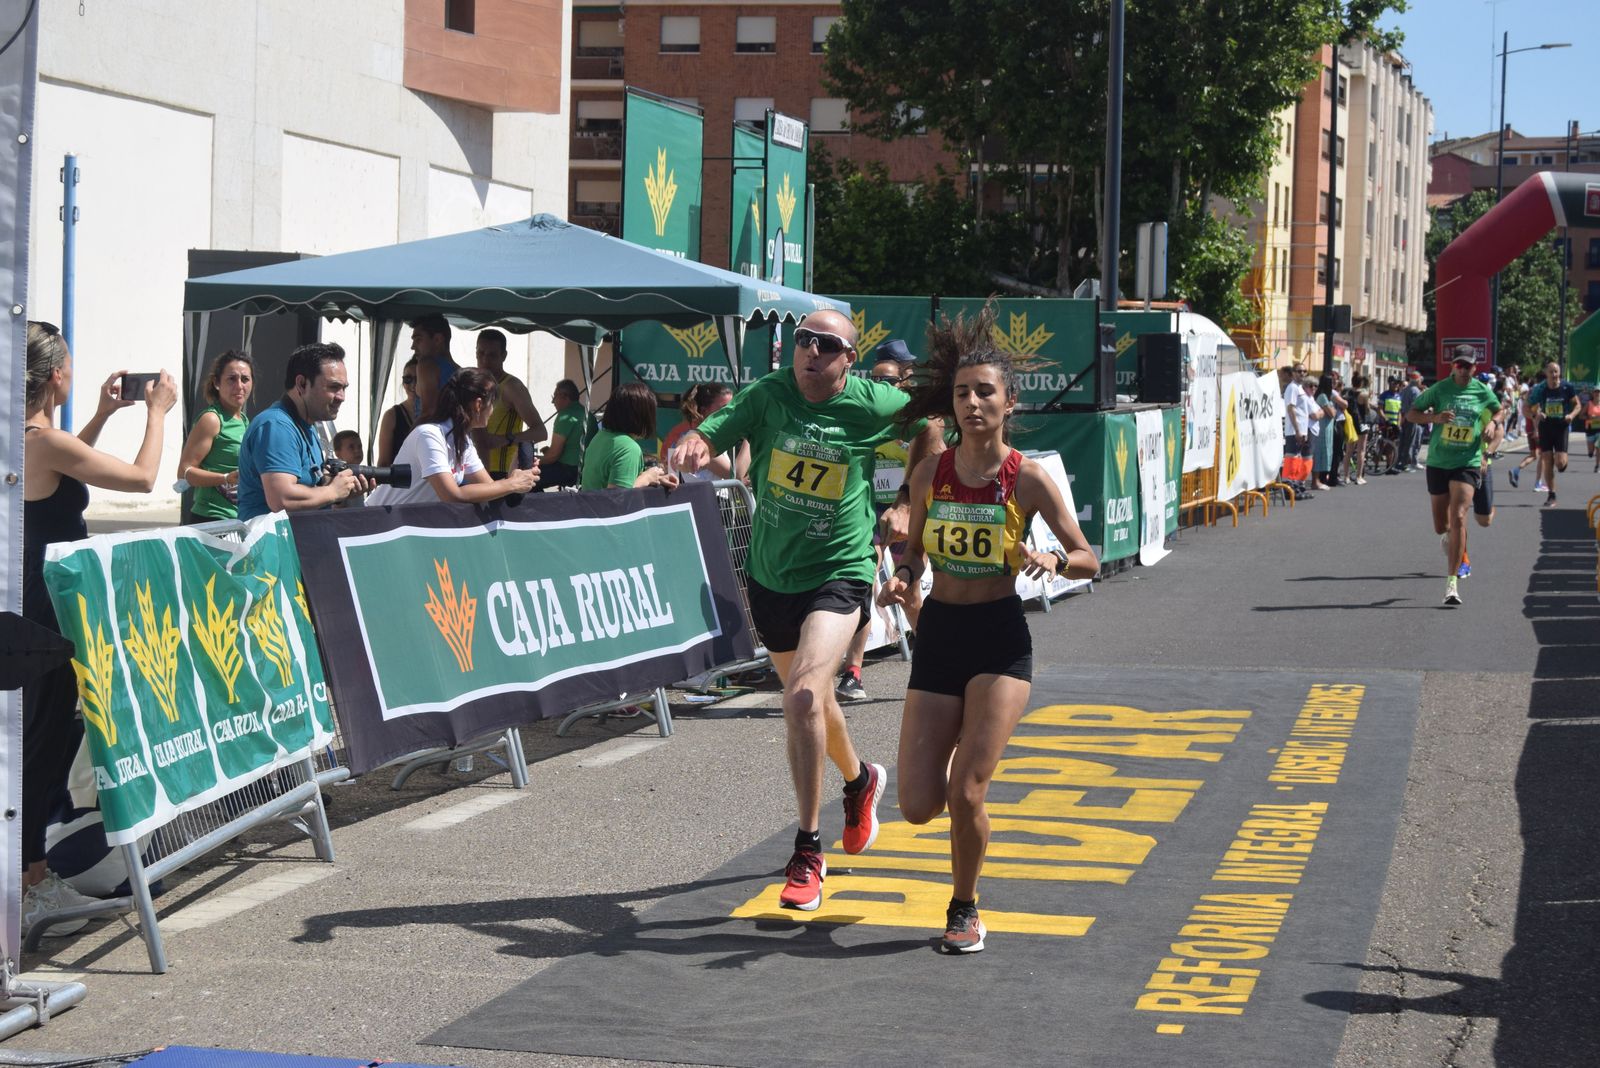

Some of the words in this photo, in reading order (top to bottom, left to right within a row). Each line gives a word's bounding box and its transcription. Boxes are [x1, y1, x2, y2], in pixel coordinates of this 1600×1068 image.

[634, 363, 681, 382] CAJA
[1447, 426, 1469, 440] 147
[815, 451, 841, 463] RURAL
[786, 460, 829, 491] 47
[806, 499, 835, 512] RURAL
[949, 505, 995, 516] FUNDACION
[968, 515, 994, 523] RURAL
[933, 525, 992, 558] 136
[967, 567, 998, 575] RURAL
[487, 578, 575, 657] CAJA
[569, 563, 675, 642] RURAL
[153, 741, 178, 768] CAJA
[175, 728, 207, 760] RURAL
[1211, 802, 1329, 884] INTEGRAL
[1134, 893, 1294, 1015] REFORMA
